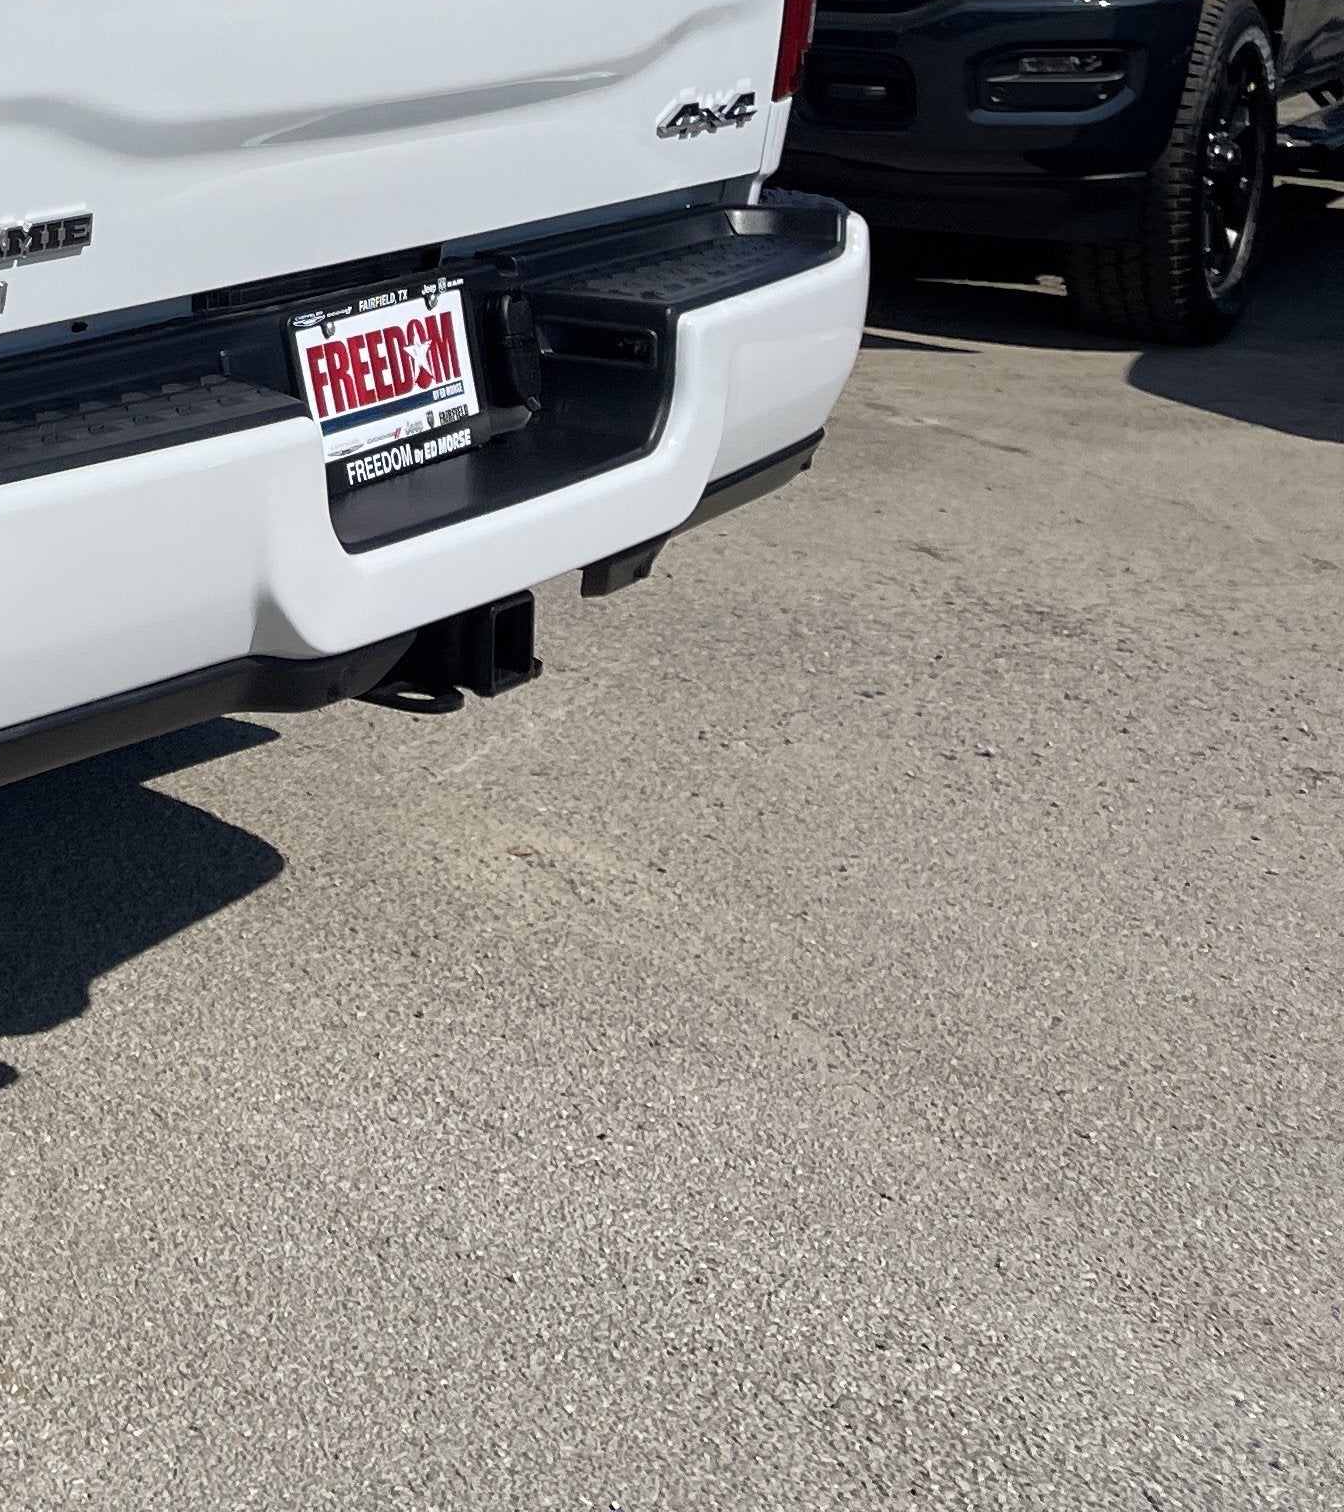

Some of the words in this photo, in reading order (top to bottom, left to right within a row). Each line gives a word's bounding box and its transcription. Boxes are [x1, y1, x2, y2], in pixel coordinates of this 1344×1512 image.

[397, 288, 408, 301] TX
[306, 311, 462, 419] FREEDOM
[346, 443, 414, 486] FREEDOM
[424, 440, 438, 460] ED
[438, 428, 472, 456] MORSE
